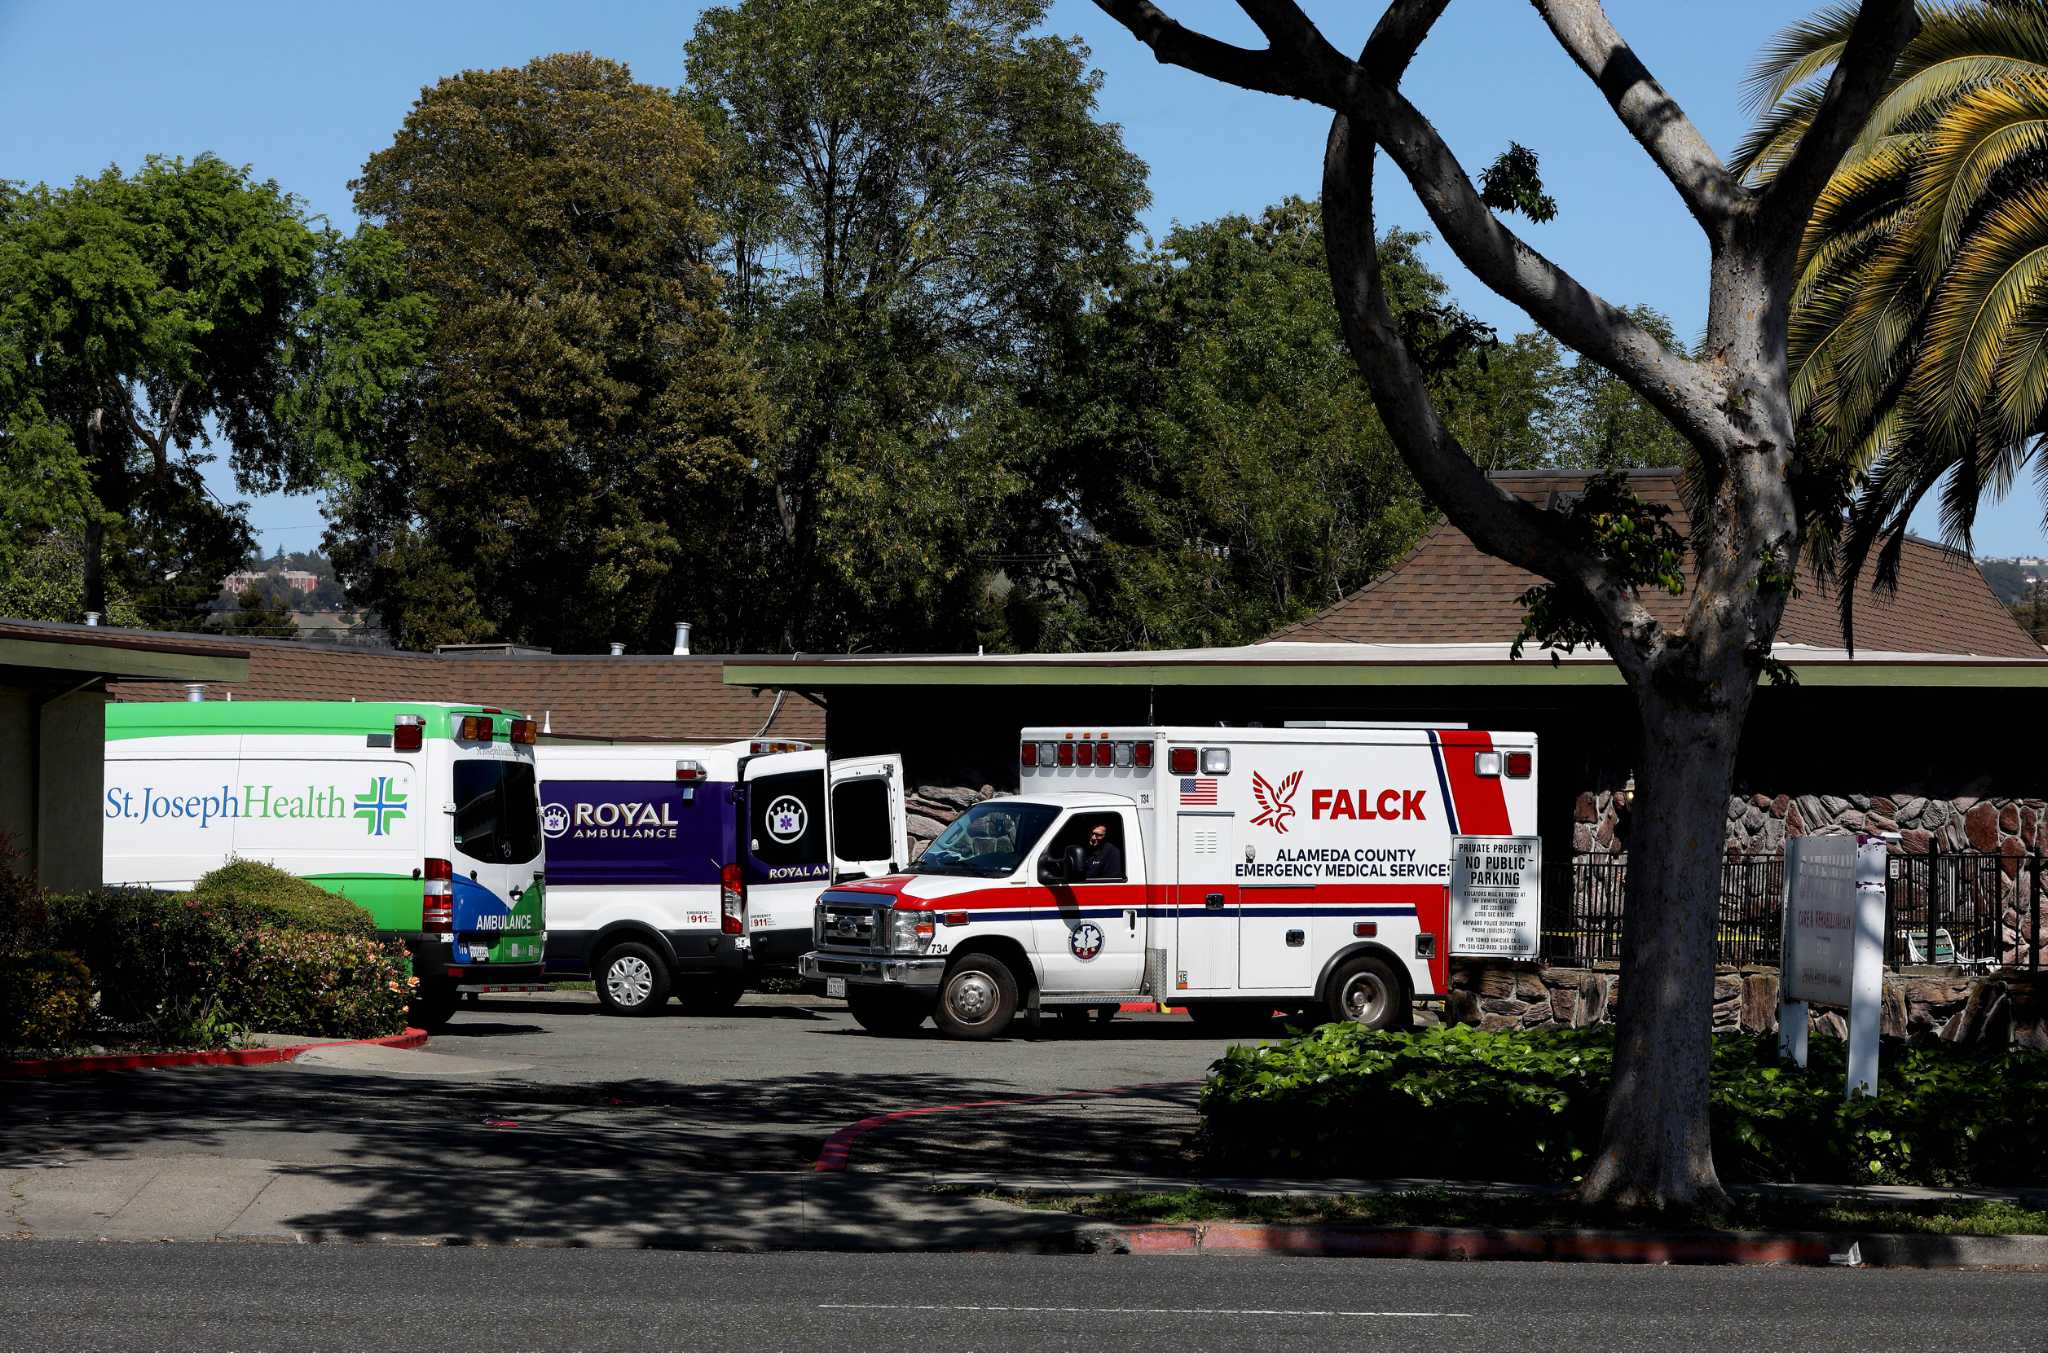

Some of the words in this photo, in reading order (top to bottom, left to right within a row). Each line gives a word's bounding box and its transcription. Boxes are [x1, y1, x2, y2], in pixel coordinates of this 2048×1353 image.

[1311, 789, 1426, 821] FALCK
[574, 802, 679, 828] ROYAL
[573, 829, 678, 840] AMBULANCE
[1276, 848, 1350, 862] ALAMEDA
[1354, 848, 1416, 862] COUNTY
[1459, 843, 1490, 853] PRIVATE
[1493, 844, 1532, 854] PROPERTY
[1235, 863, 1321, 877] EMERGENCY
[1325, 863, 1387, 877] MEDICAL
[1465, 856, 1480, 870] NO
[1486, 856, 1525, 870] PUBLIC
[769, 866, 811, 879] ROYAL
[1470, 871, 1520, 885] PARKING
[476, 914, 532, 930] AMBULANCE
[691, 915, 708, 923] 911
[753, 918, 767, 927] 911
[931, 943, 948, 954] 734
